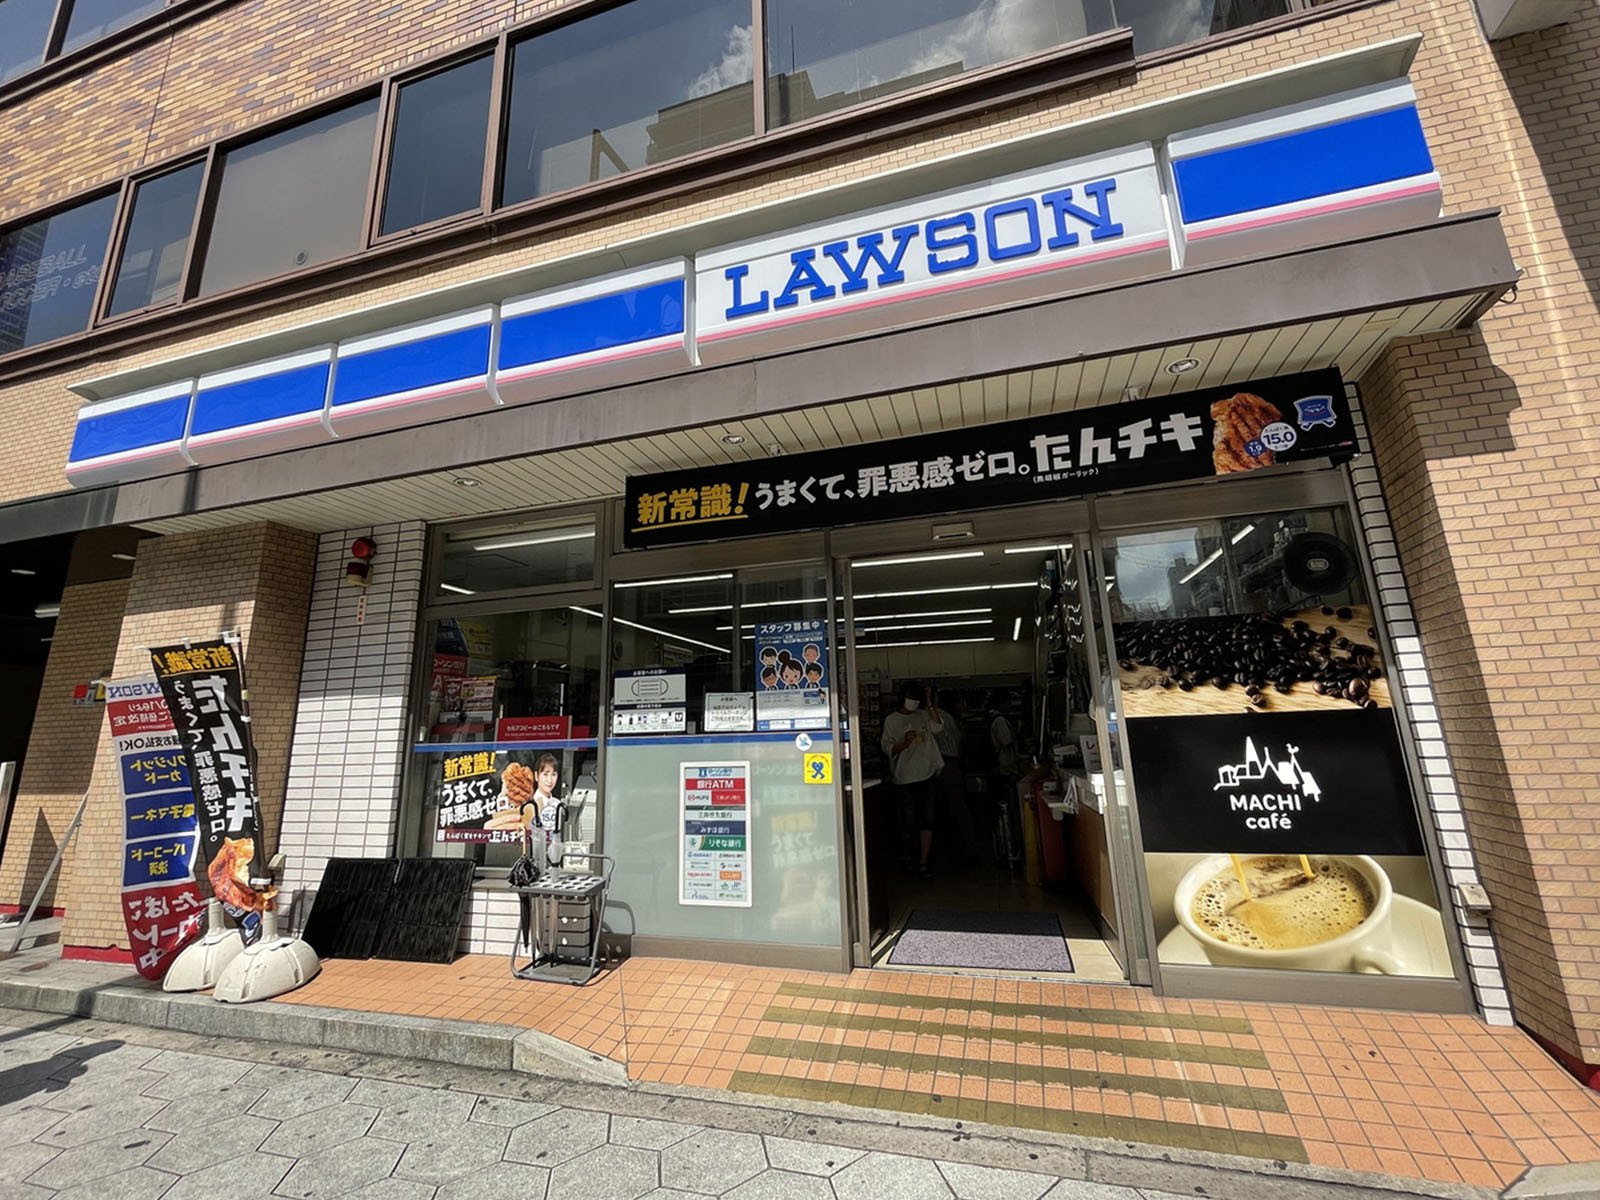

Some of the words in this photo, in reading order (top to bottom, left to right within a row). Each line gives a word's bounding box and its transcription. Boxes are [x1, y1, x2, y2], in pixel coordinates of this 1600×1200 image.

[725, 178, 1125, 320] LAWSON
[1263, 431, 1295, 445] 15.0
[637, 482, 750, 525] 新常識!
[755, 450, 1030, 510] うまくて、罪悪感ゼロ。
[1030, 413, 1203, 472] たんチキ
[444, 752, 496, 777] 新常識!
[441, 779, 492, 806] うまくて、
[697, 780, 734, 789] 銀行ATM
[439, 796, 514, 827] 罪悪感ゼロ。
[1230, 794, 1301, 811] MACHI
[1245, 812, 1292, 829] café
